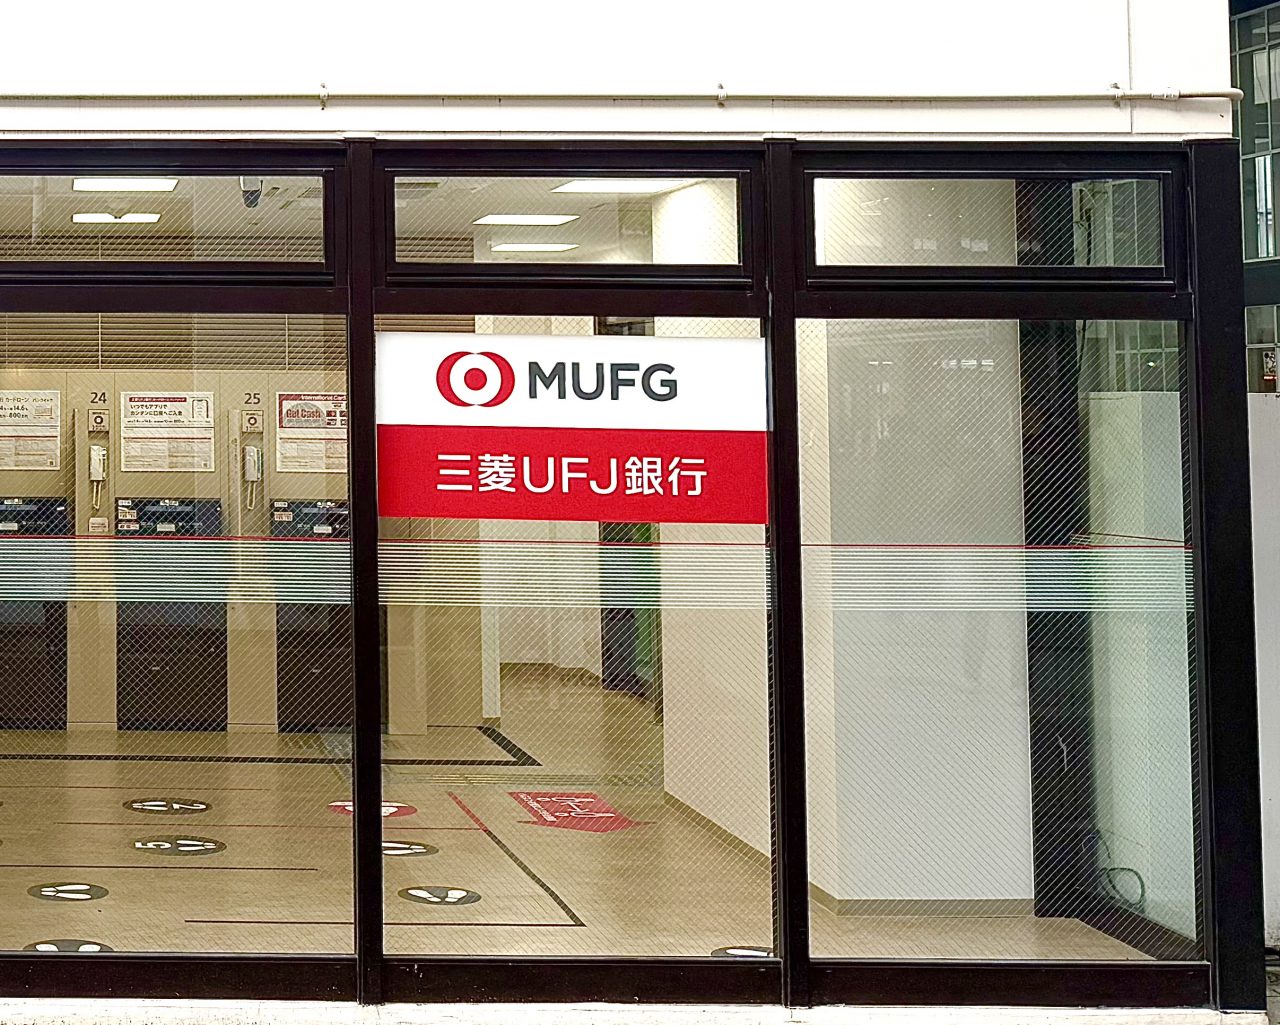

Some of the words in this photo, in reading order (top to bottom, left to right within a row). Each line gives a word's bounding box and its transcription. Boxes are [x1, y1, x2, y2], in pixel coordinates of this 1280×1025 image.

[528, 361, 678, 402] MUFG
[90, 392, 107, 404] 24
[244, 393, 261, 404] 25
[436, 453, 707, 496] 三菱UFJ銀行
